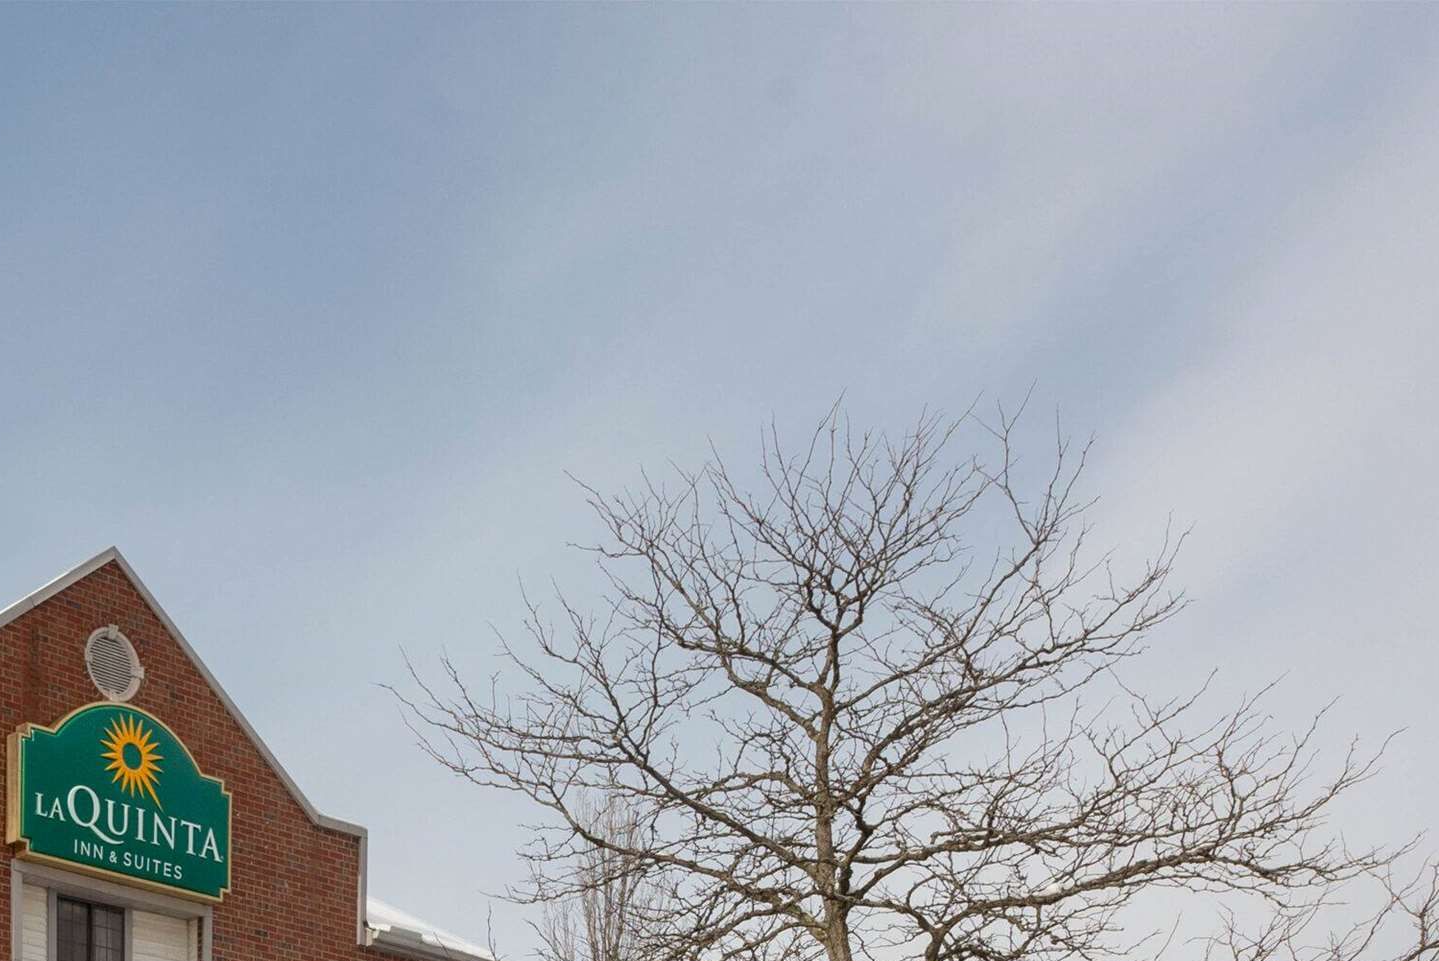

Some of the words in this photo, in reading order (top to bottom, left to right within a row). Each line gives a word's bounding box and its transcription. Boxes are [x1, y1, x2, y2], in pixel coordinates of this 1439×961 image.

[34, 792, 66, 822] LA
[67, 785, 223, 863] QUINTA
[73, 839, 104, 861] INN
[108, 850, 118, 864] &
[123, 852, 183, 880] SUITES
